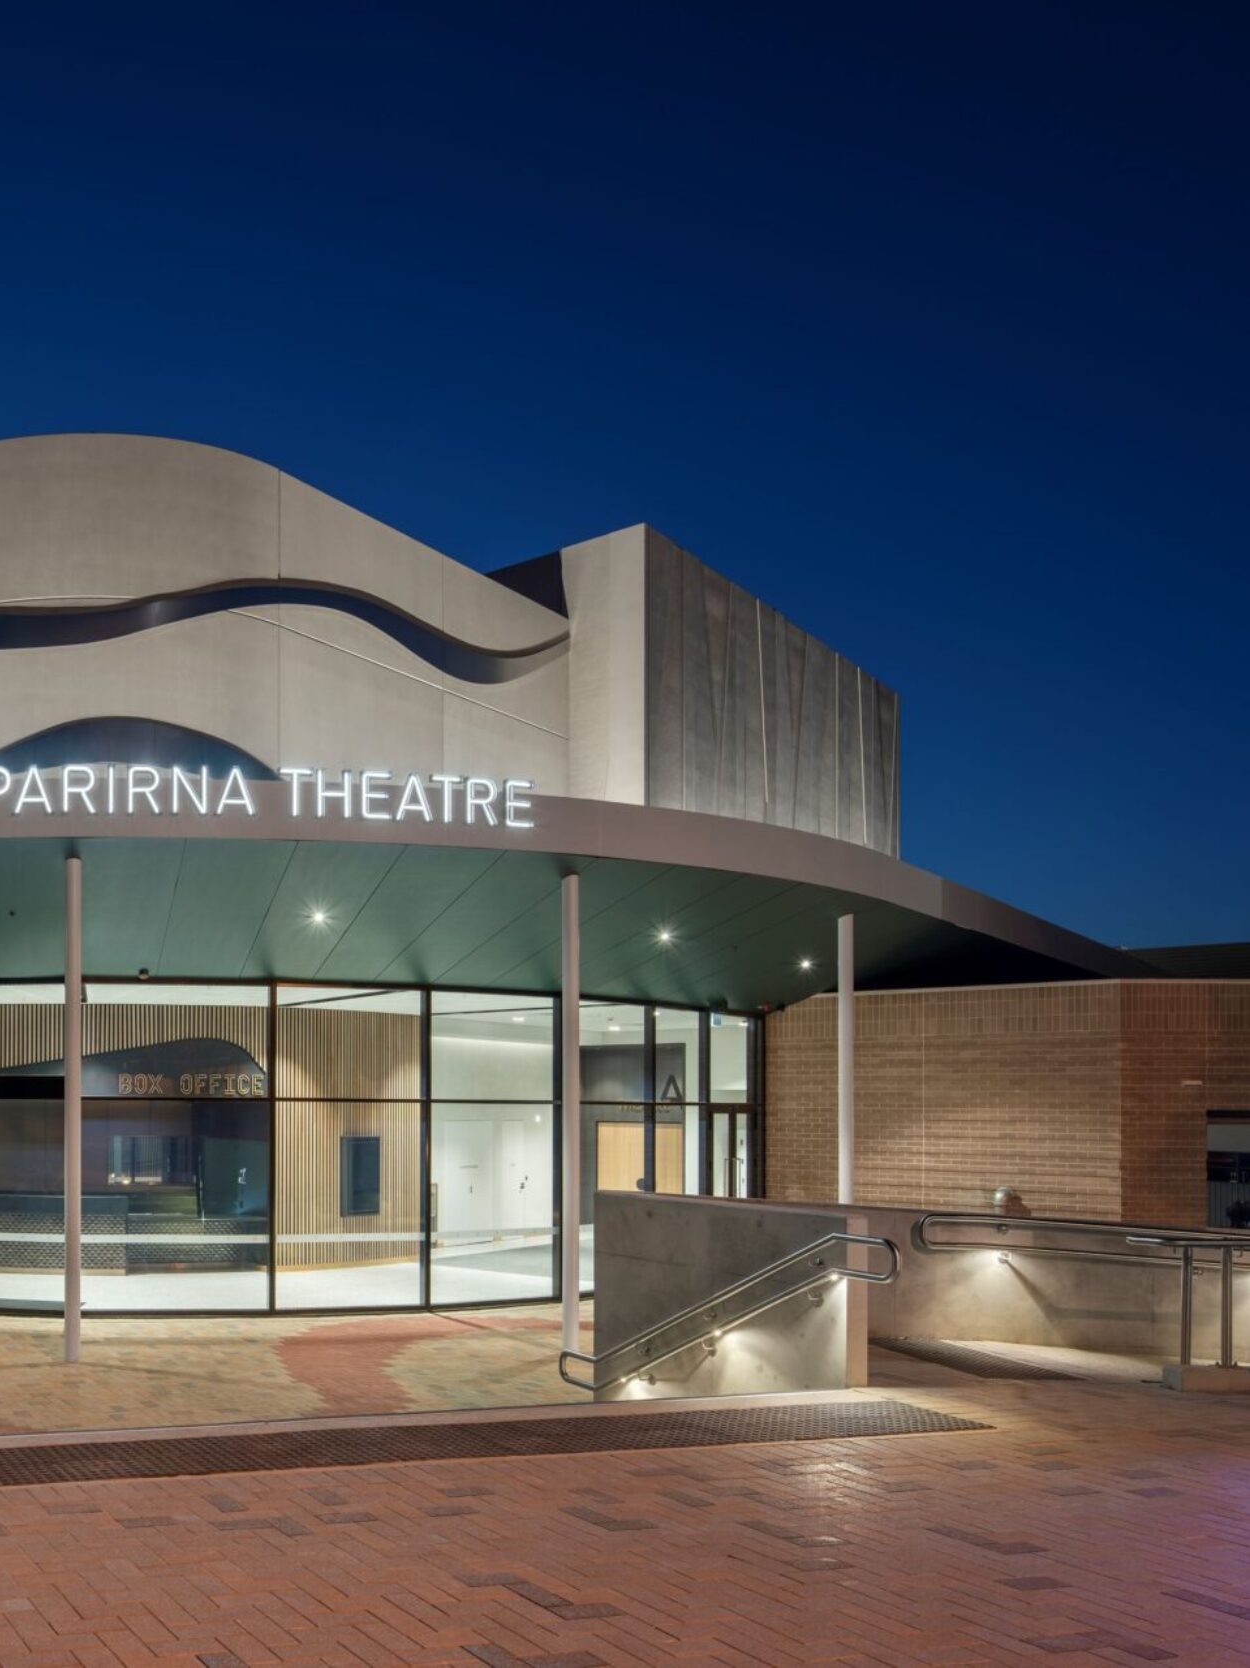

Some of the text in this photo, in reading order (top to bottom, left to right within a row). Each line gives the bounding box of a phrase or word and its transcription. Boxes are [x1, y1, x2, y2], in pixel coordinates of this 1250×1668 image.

[277, 766, 535, 829] THEATRE
[118, 1073, 265, 1096] BOX OFFICE
